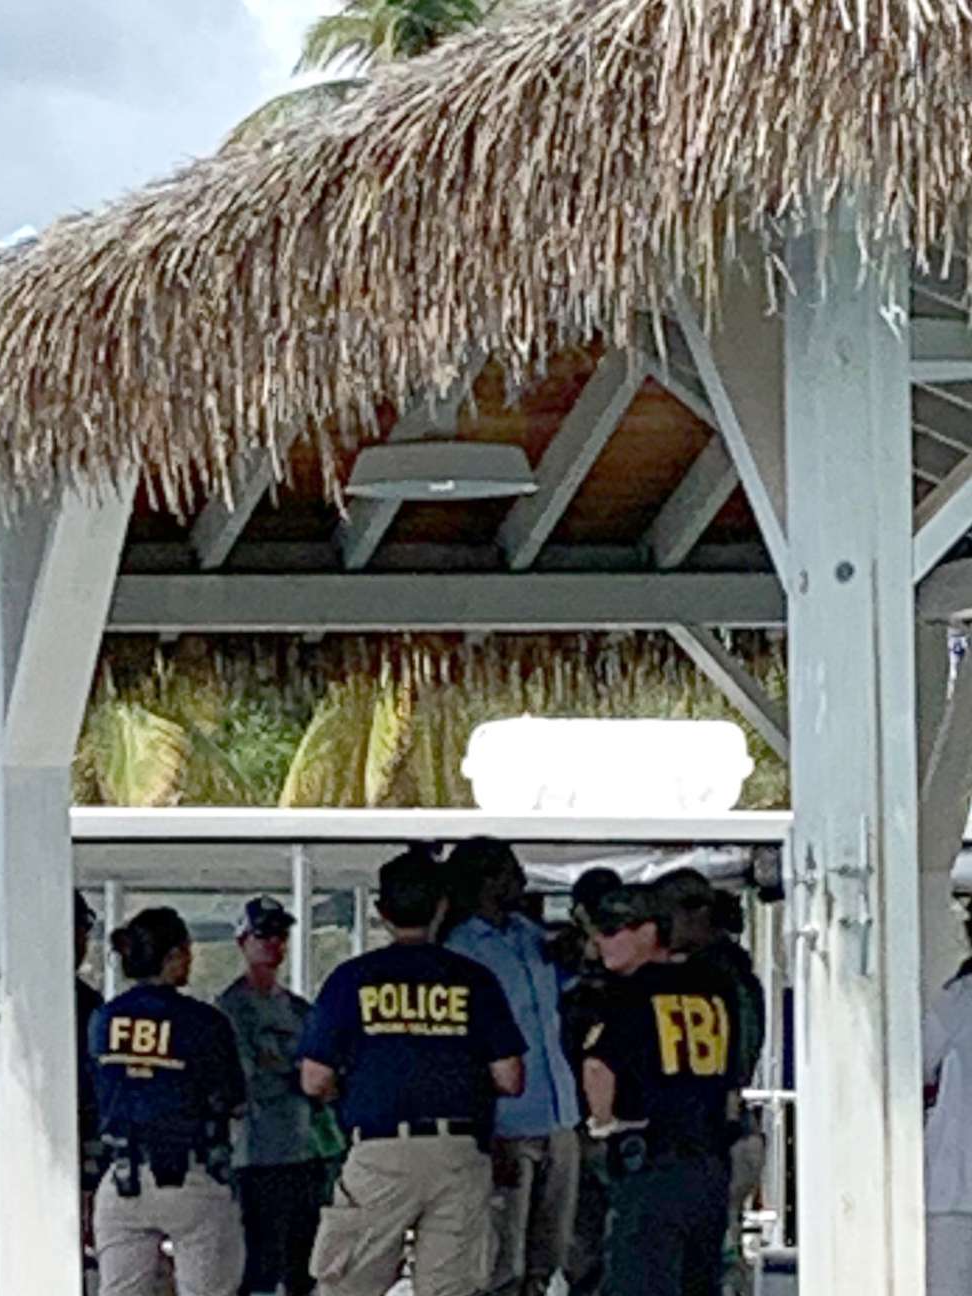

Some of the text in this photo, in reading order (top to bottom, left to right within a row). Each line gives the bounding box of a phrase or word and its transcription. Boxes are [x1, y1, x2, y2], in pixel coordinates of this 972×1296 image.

[359, 983, 469, 1022] POLICE
[109, 1016, 171, 1055] FBI
[650, 994, 728, 1076] FBI
